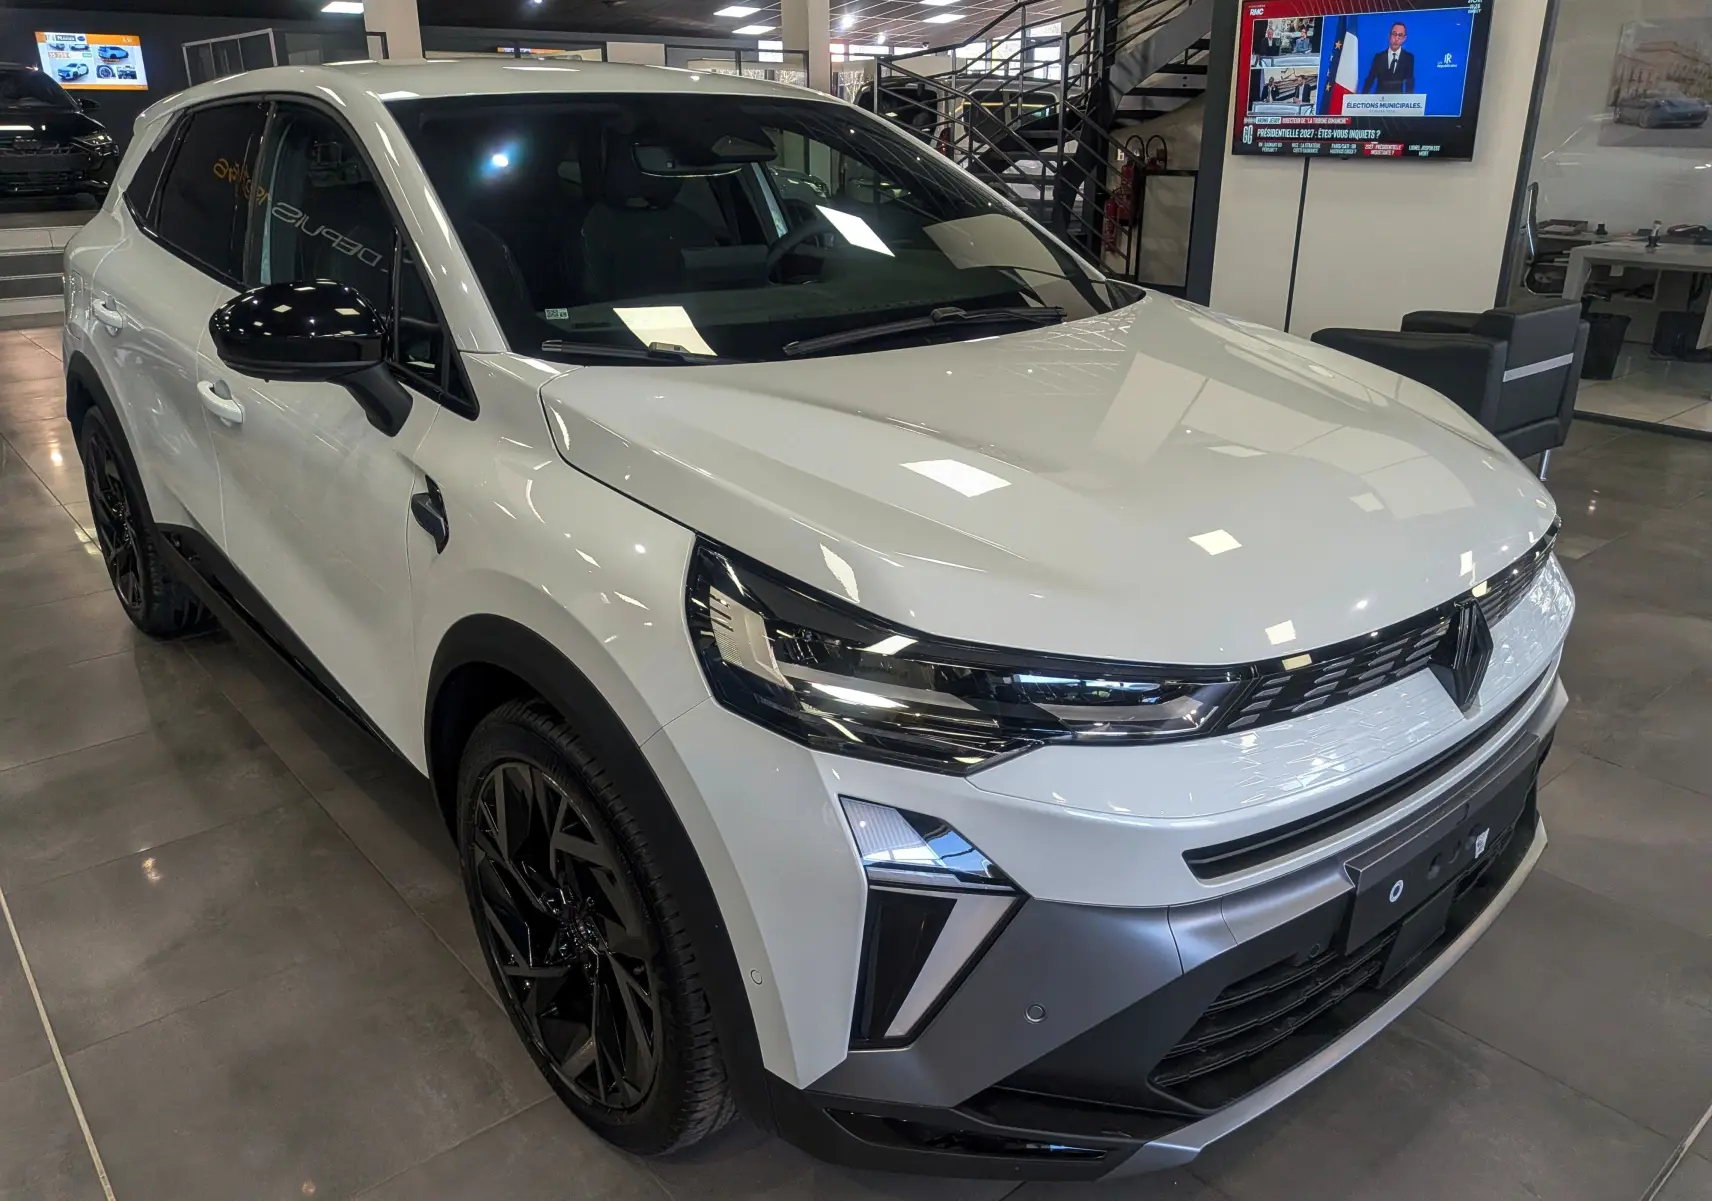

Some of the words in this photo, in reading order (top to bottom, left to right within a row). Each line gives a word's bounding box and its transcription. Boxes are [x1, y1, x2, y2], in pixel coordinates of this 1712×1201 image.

[1346, 101, 1379, 109] ÉLECTIONS
[1257, 127, 1299, 138] PRÉSIDENTIELLE
[1300, 129, 1314, 138] 2027
[1318, 128, 1348, 138] ÊTES-VOUS
[1349, 129, 1375, 140] INQUIETS
